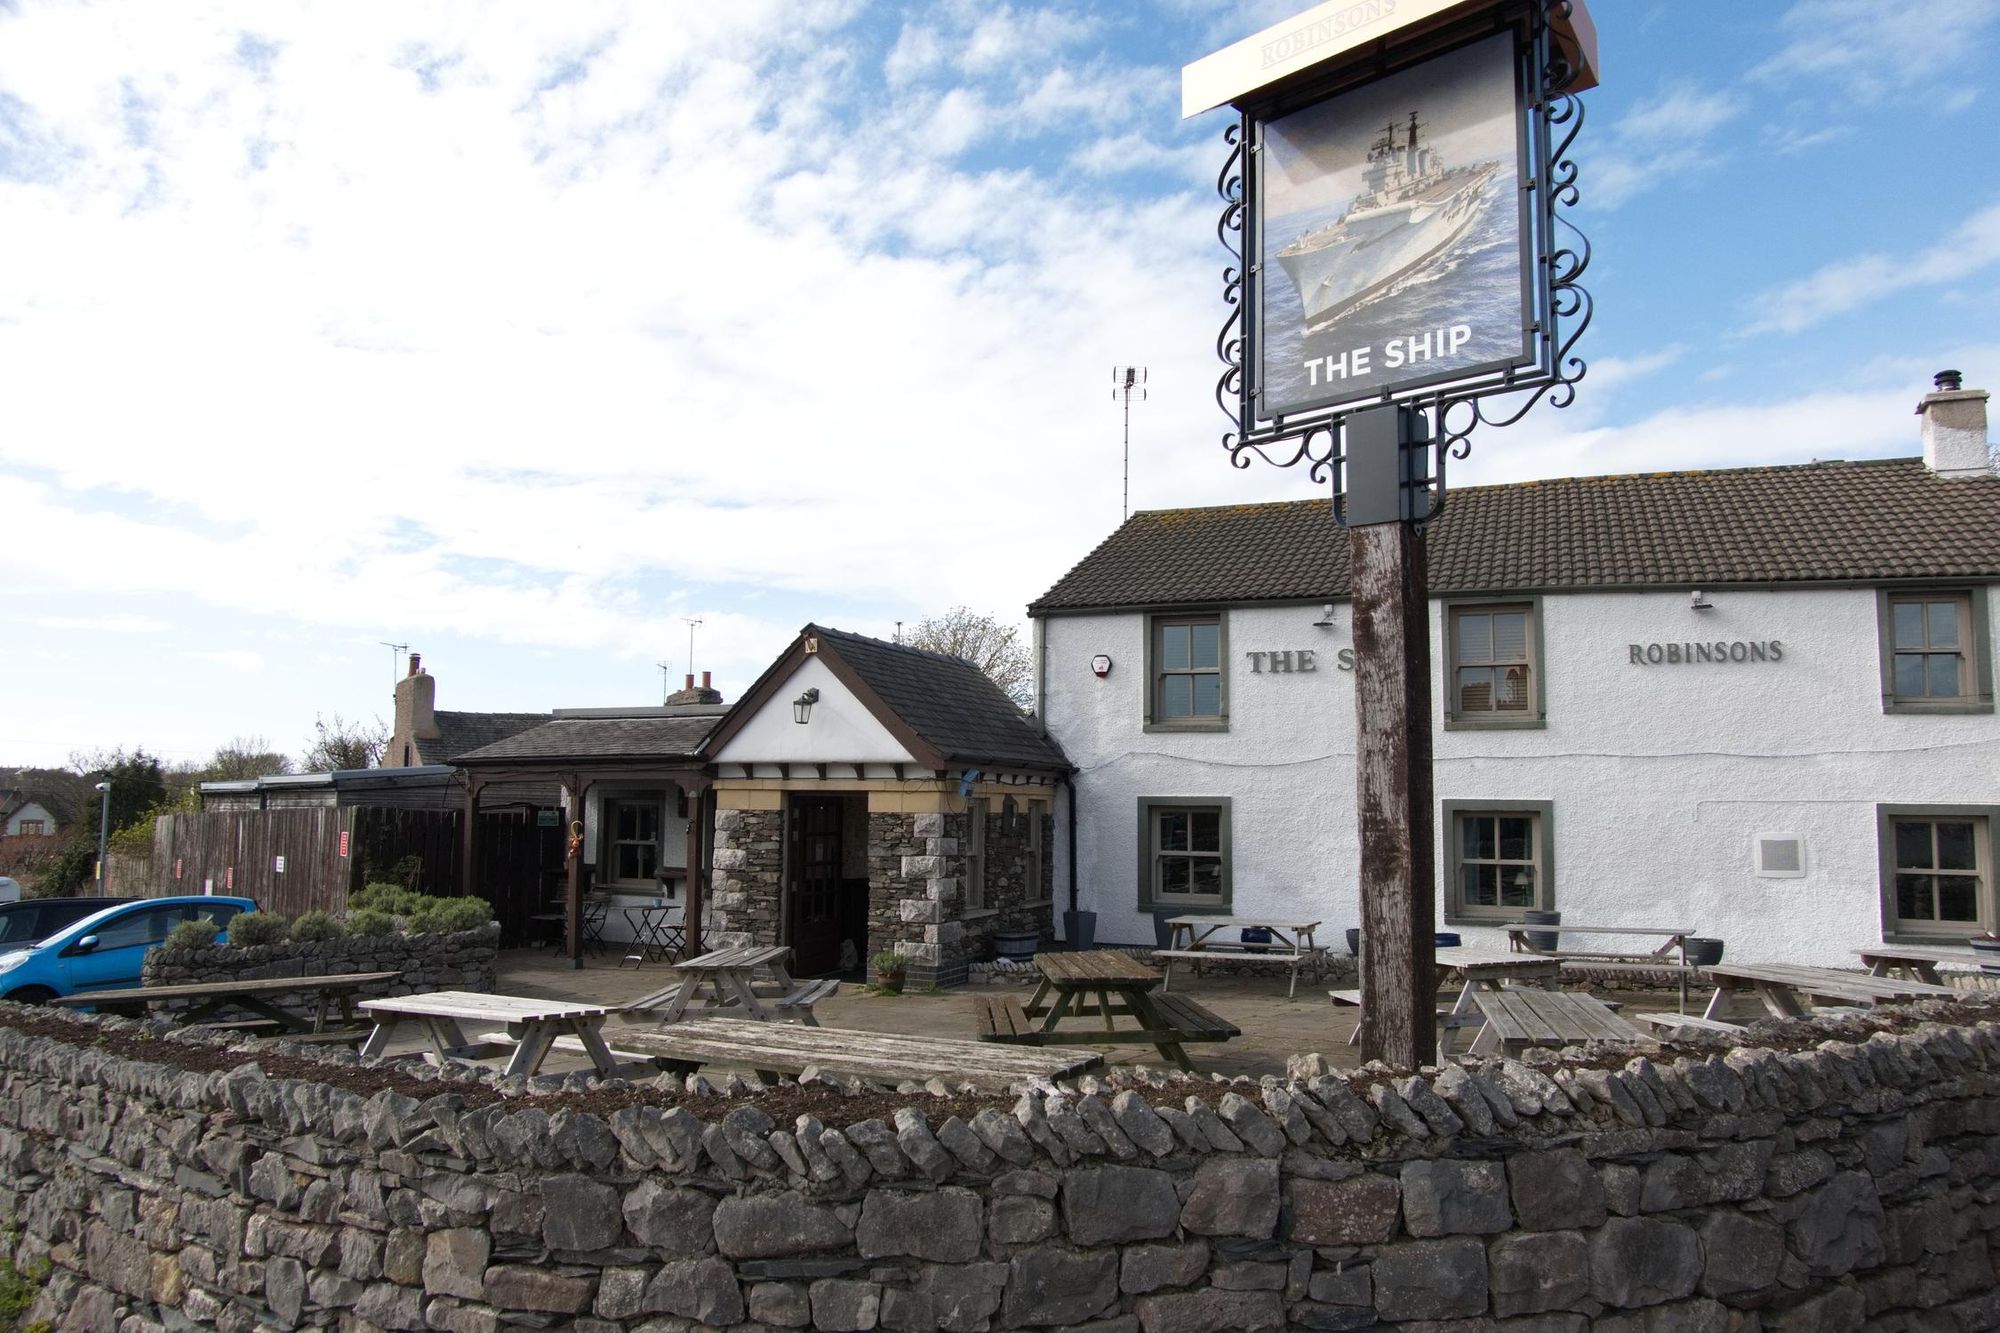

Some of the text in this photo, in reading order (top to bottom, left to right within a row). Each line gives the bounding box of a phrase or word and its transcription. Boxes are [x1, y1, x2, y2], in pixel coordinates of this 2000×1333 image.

[1261, 0, 1396, 66] ROBINSONS
[1303, 324, 1472, 386] THE SHIP
[1246, 650, 1316, 673] THE
[1628, 640, 1783, 665] ROBINSONS
